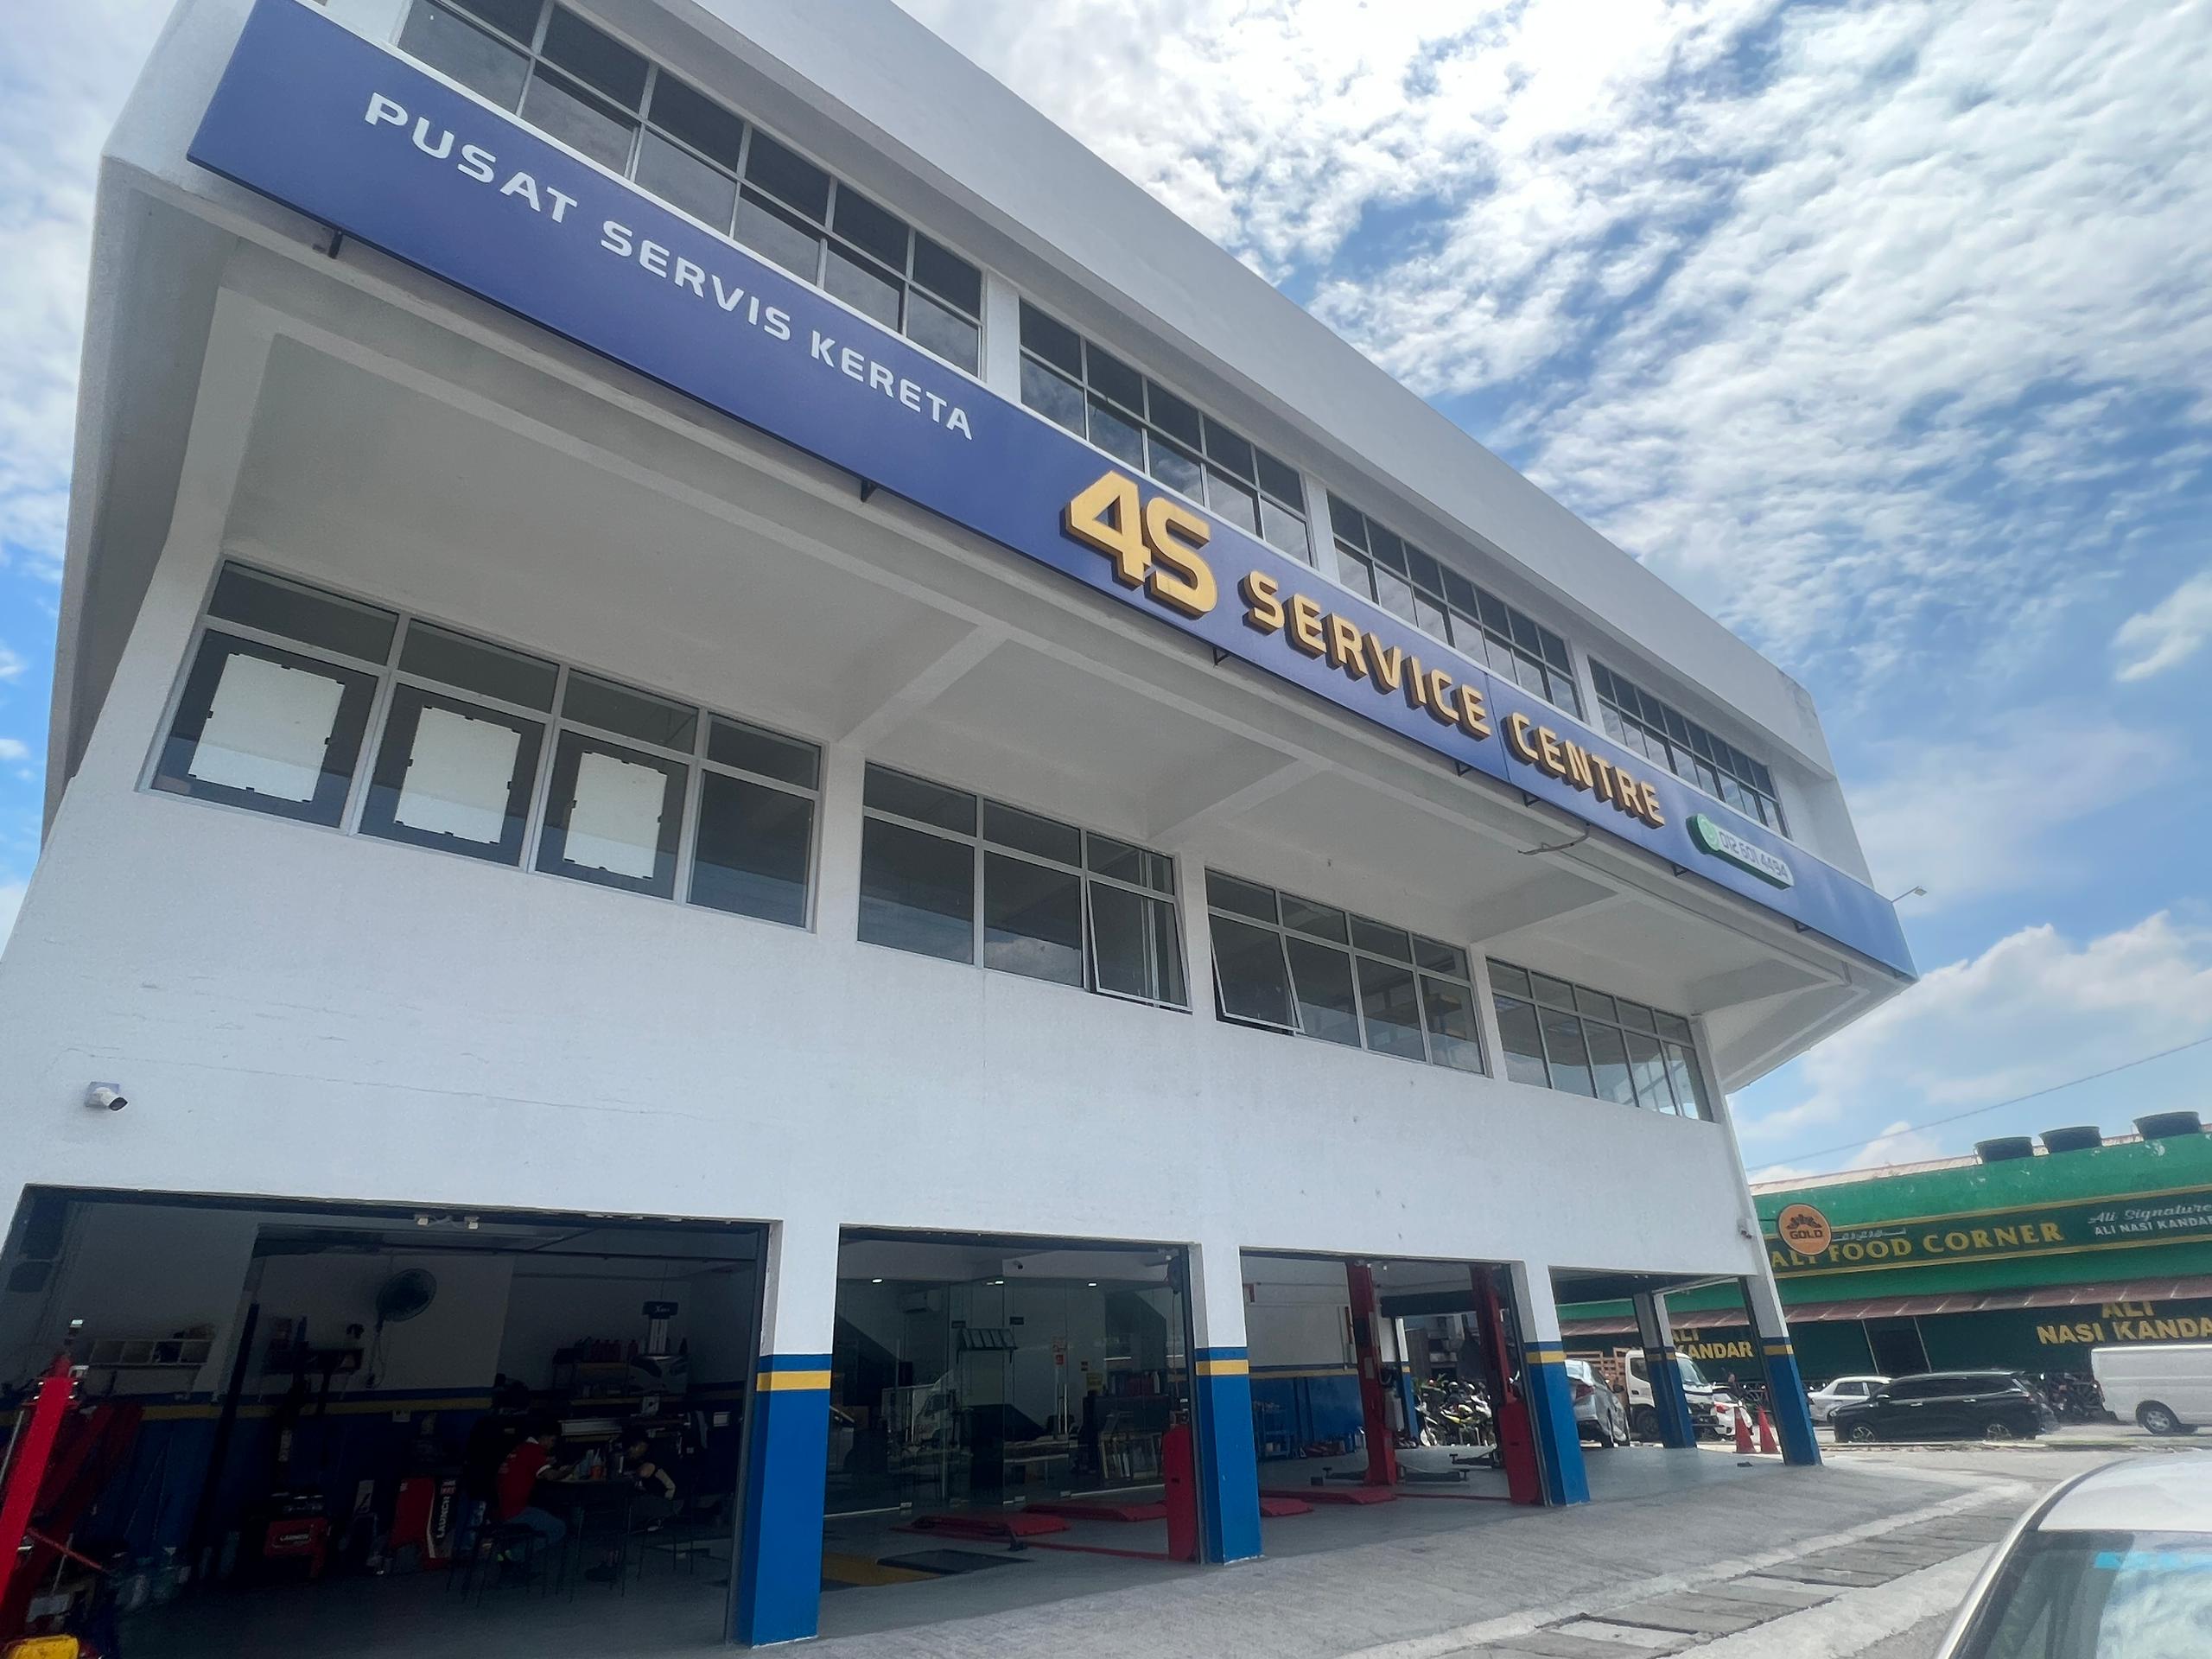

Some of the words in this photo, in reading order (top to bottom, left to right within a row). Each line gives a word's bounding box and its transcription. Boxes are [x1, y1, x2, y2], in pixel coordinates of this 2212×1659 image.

[365, 92, 577, 223] PUSAT
[601, 220, 791, 340] SERVIS
[810, 331, 973, 440] KERETA
[1065, 471, 1217, 618] 4S
[1242, 571, 1491, 740] SERVICE
[1503, 712, 1666, 828] CENTRE
[1719, 831, 1739, 854] 012
[1738, 842, 1759, 864] 601
[2088, 1211, 2115, 1224] Ali
[2125, 1204, 2212, 1221] Signature
[1789, 1229, 1823, 1240] GOLD
[2095, 1225, 2116, 1236] ALI
[2120, 1221, 2153, 1232] NASI
[1828, 1238, 1912, 1262] FOOD
[1923, 1223, 2064, 1253] CORNER
[2102, 1301, 2155, 1319] ALI
[2037, 1323, 2105, 1344] NASI
